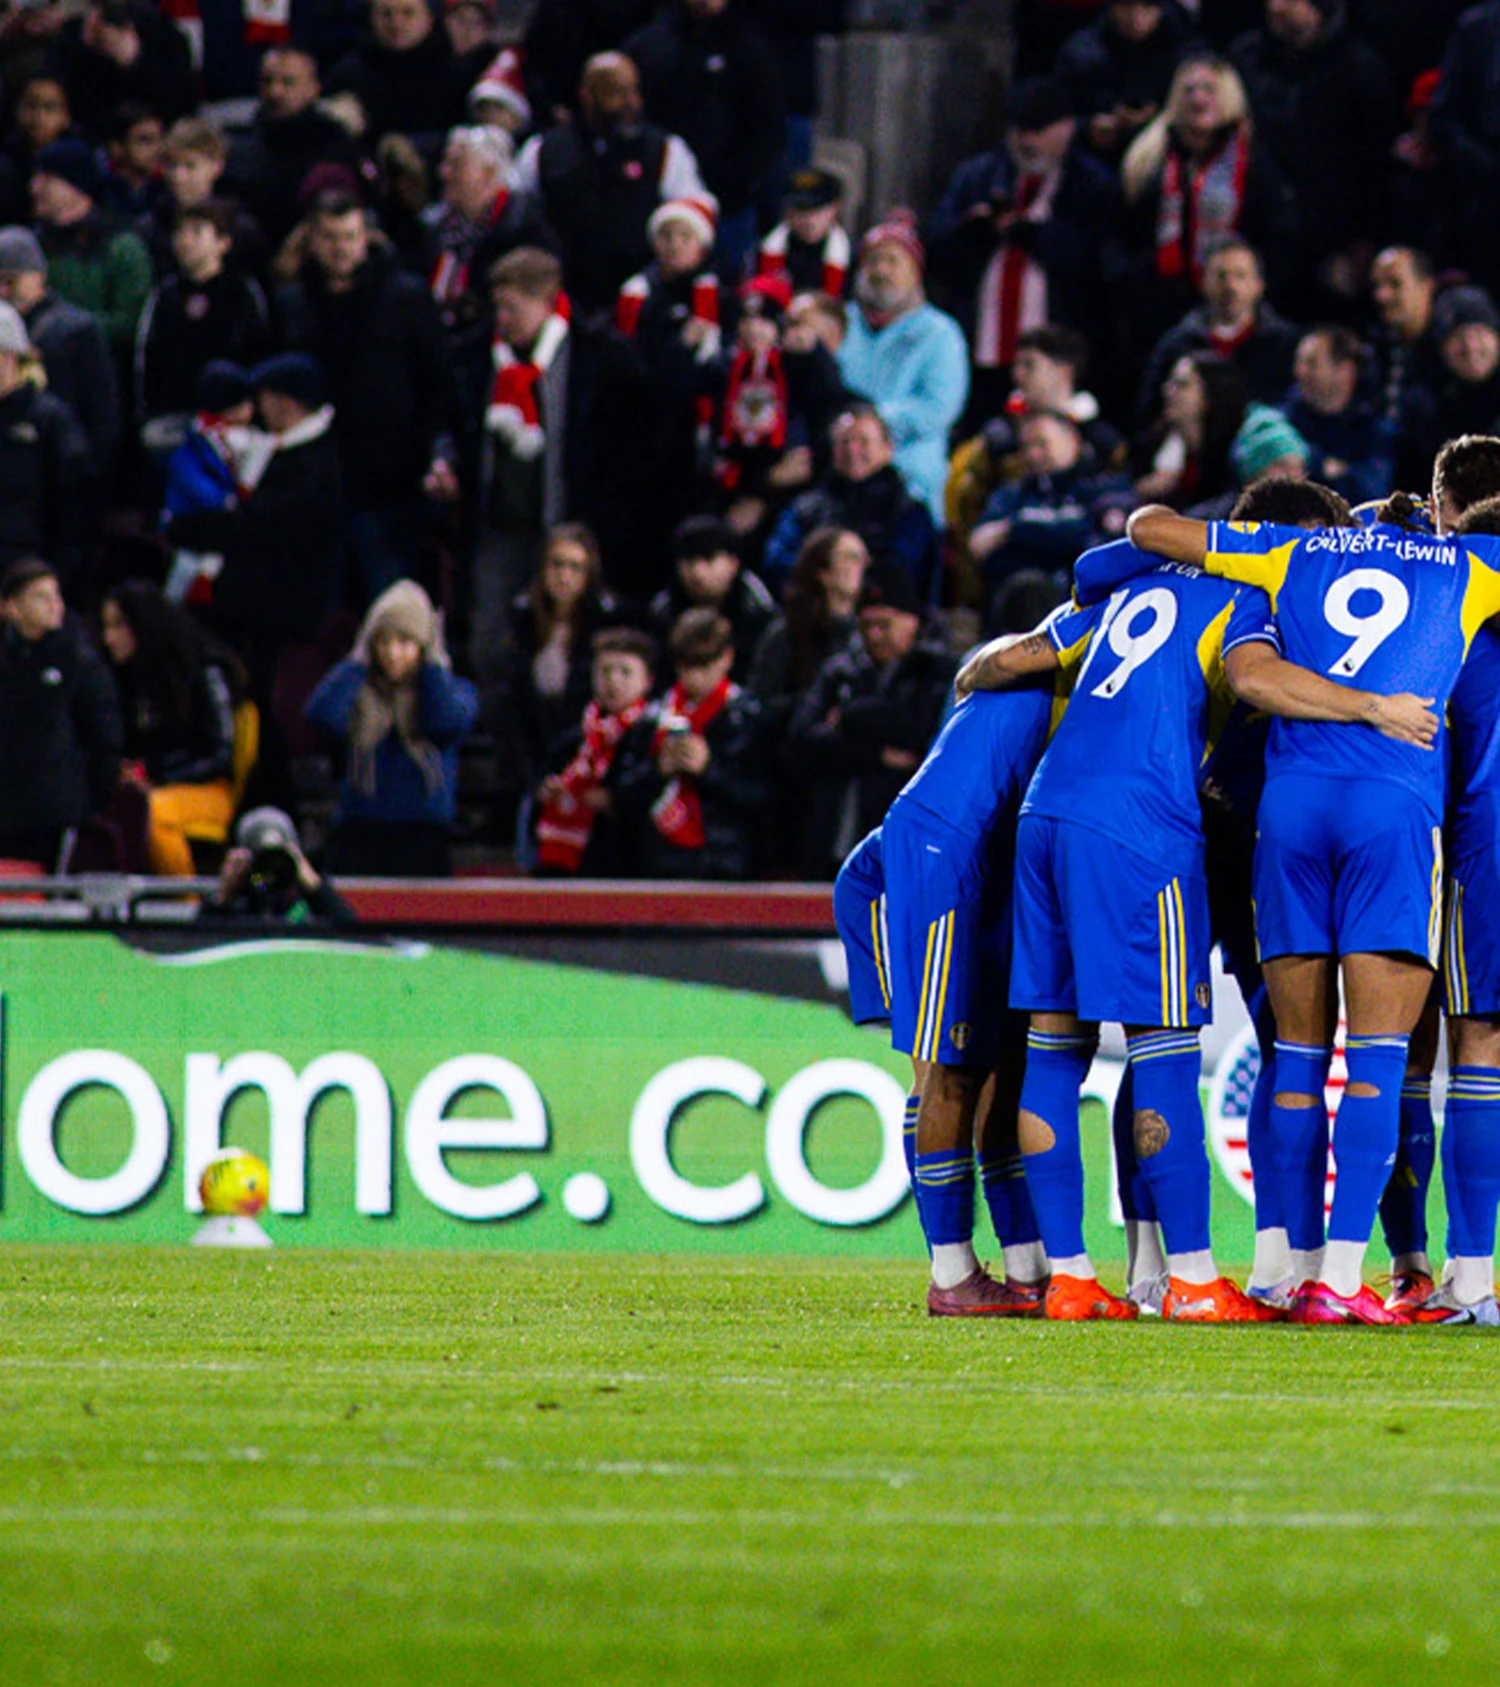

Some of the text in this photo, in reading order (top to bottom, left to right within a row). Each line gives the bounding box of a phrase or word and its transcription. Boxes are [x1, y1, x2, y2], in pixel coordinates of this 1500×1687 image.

[1305, 528, 1457, 566] CALVERT-LEWIN
[1076, 587, 1177, 698] 19
[1323, 568, 1410, 677] 9
